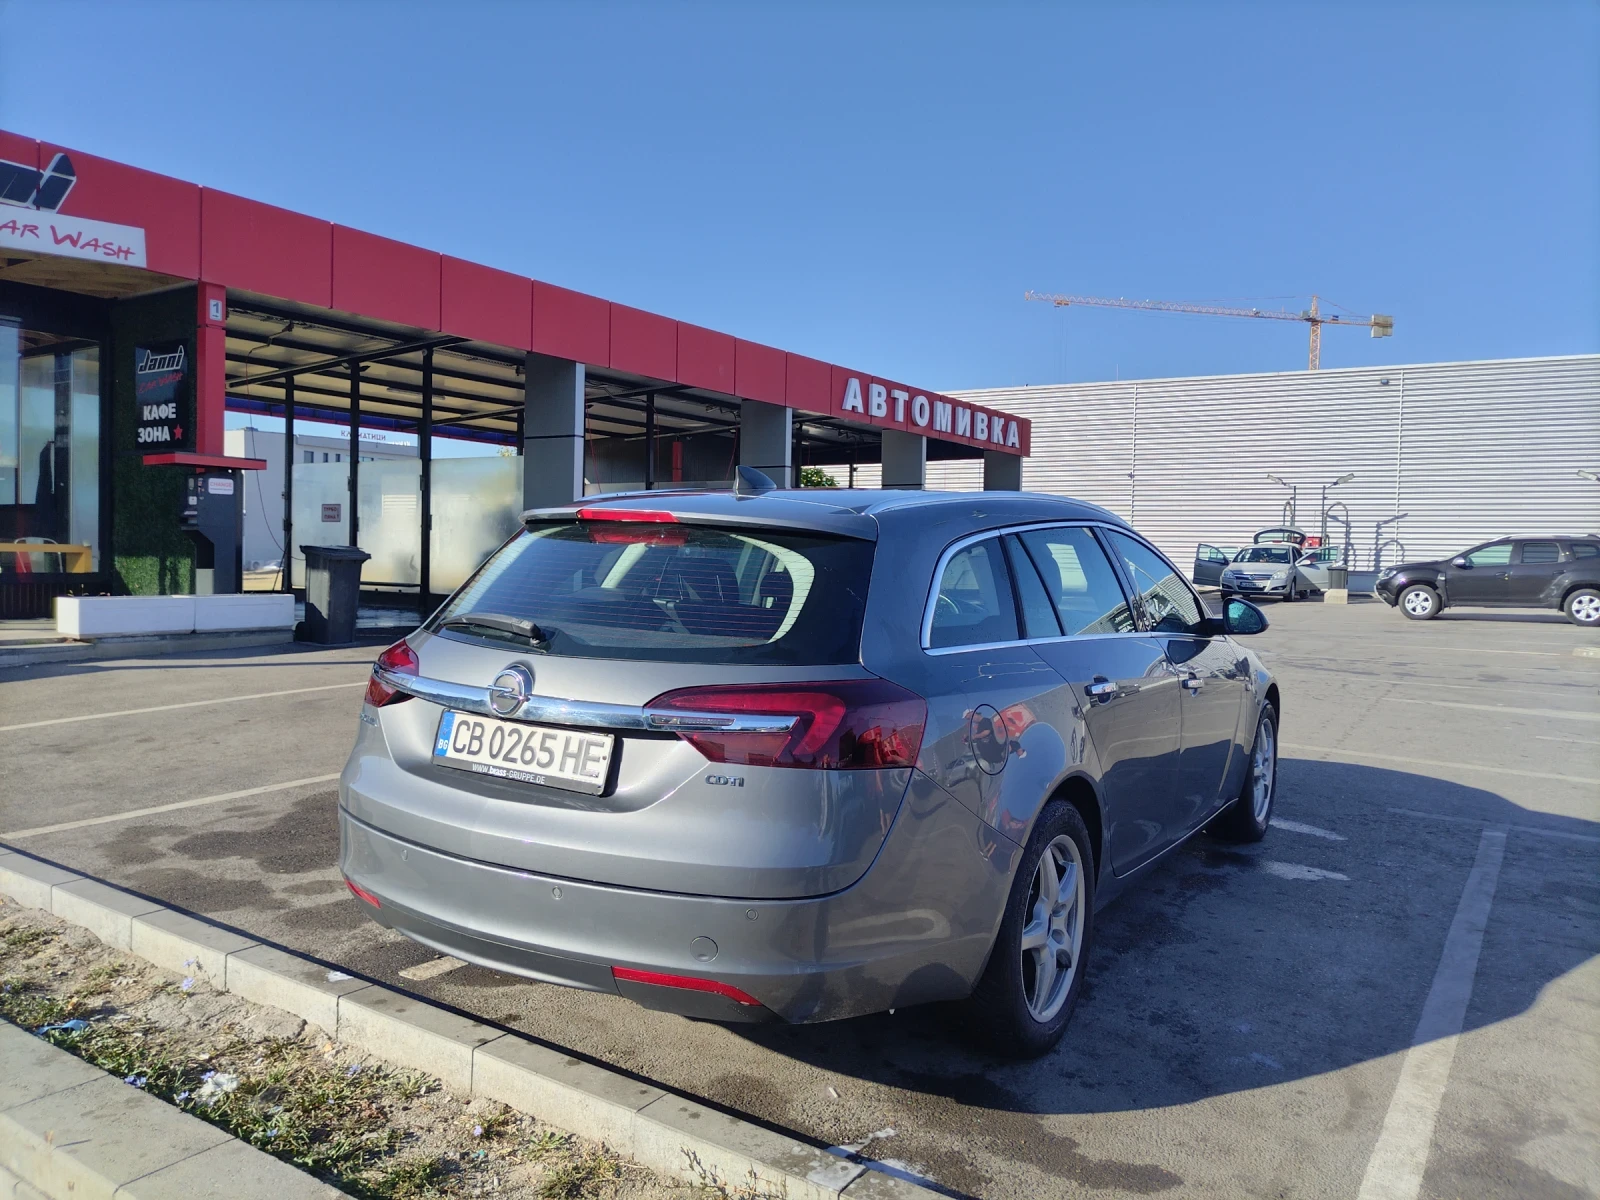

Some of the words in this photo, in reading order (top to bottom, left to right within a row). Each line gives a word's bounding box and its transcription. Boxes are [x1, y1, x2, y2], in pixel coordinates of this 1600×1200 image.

[0, 219, 40, 238] AR
[50, 225, 136, 261] WASH
[212, 302, 219, 314] 1
[138, 345, 184, 374] Janni
[143, 402, 177, 421] КАФЕ
[842, 377, 1020, 448] АВТОМИВКА
[137, 425, 171, 443] ЗОНА
[340, 430, 387, 441] КЛМАТИЦИ
[437, 738, 448, 750] BG
[452, 719, 486, 756] CB
[488, 725, 558, 769] 0265
[558, 735, 606, 779] HE
